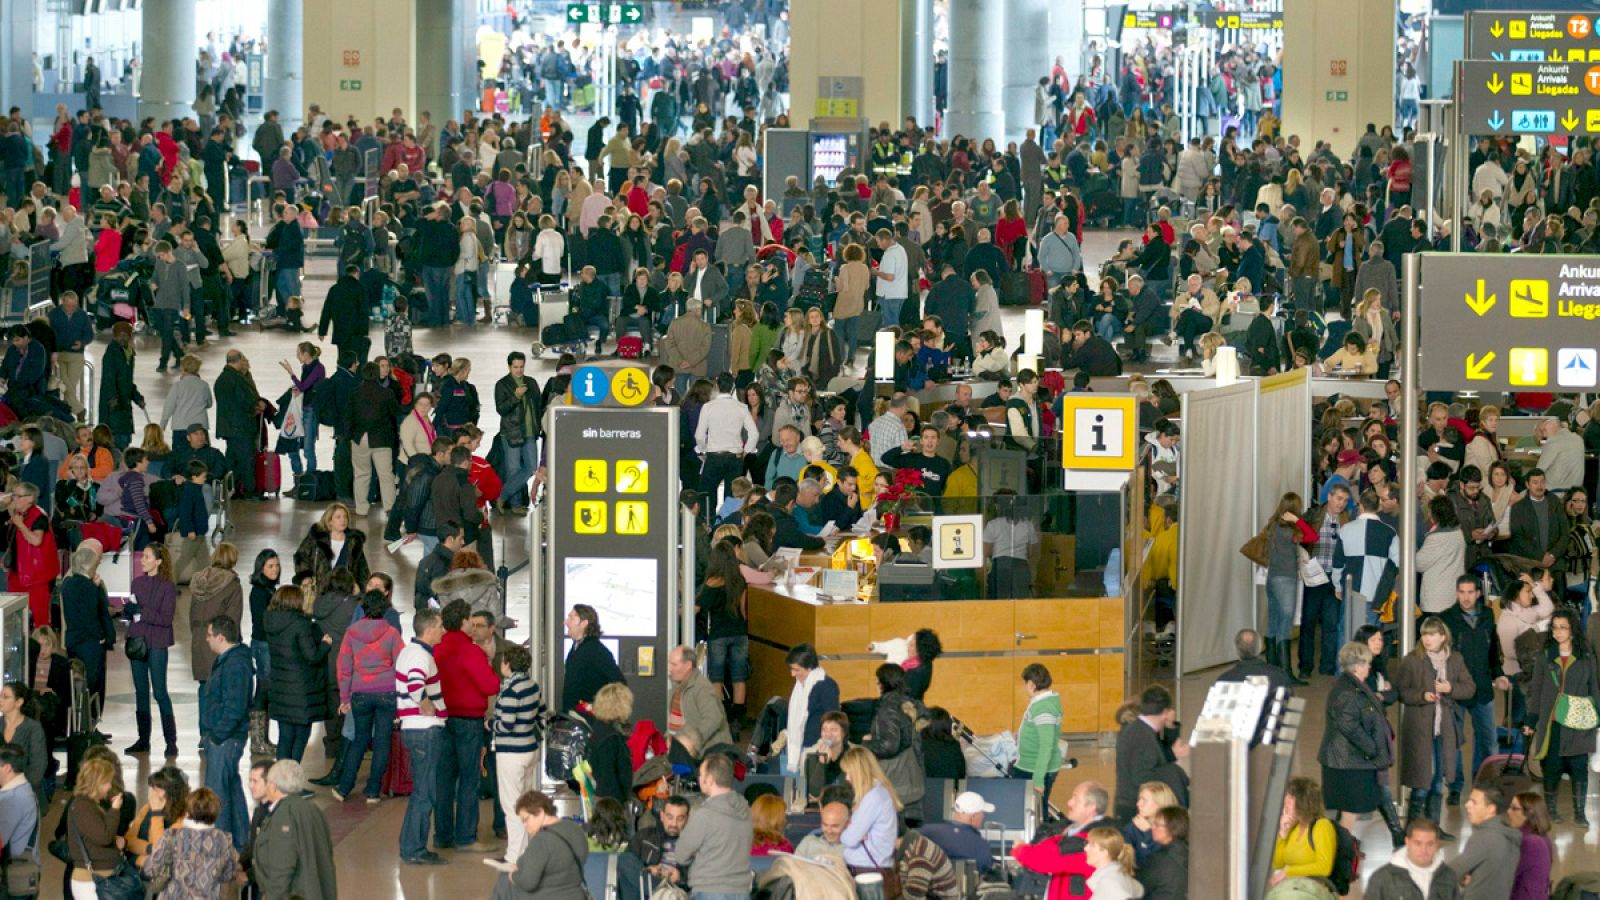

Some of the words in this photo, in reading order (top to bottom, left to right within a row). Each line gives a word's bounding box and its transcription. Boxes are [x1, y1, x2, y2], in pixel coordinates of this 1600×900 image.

[1570, 20, 1588, 33] T2
[1530, 30, 1563, 39] Llegadas
[1537, 65, 1569, 73] Ankunft
[1537, 75, 1567, 84] Arrivals
[1588, 72, 1600, 88] T
[1537, 85, 1579, 96] Llegadas
[582, 428, 598, 438] sin
[600, 428, 641, 438] barreras
